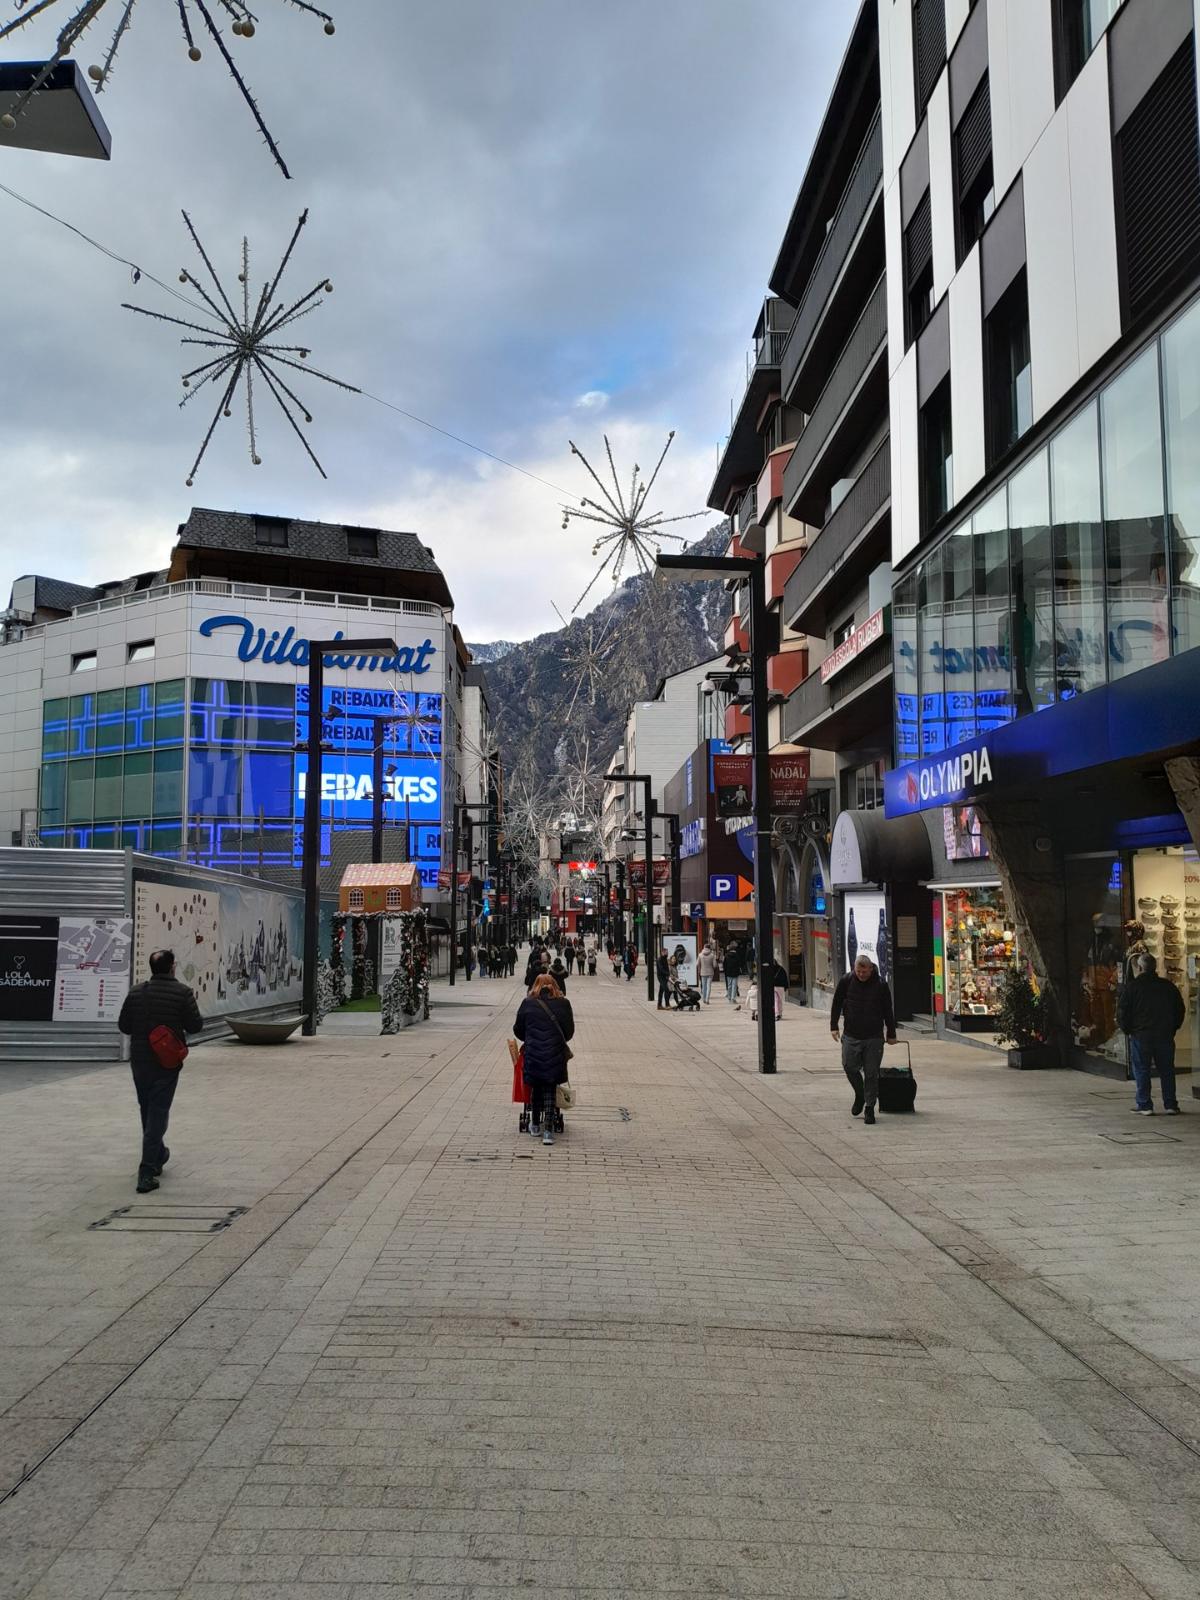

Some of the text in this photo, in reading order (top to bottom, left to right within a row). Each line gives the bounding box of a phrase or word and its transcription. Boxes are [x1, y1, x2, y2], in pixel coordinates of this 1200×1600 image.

[836, 638, 857, 666] ESCOLA
[858, 614, 882, 648] RUBEN
[331, 690, 408, 709] REBAIXES
[770, 766, 806, 779] NADAL
[920, 746, 993, 801] OLYMPIA
[715, 879, 731, 897] P
[860, 941, 874, 952] CHANEL
[5, 971, 31, 979] LOLA
